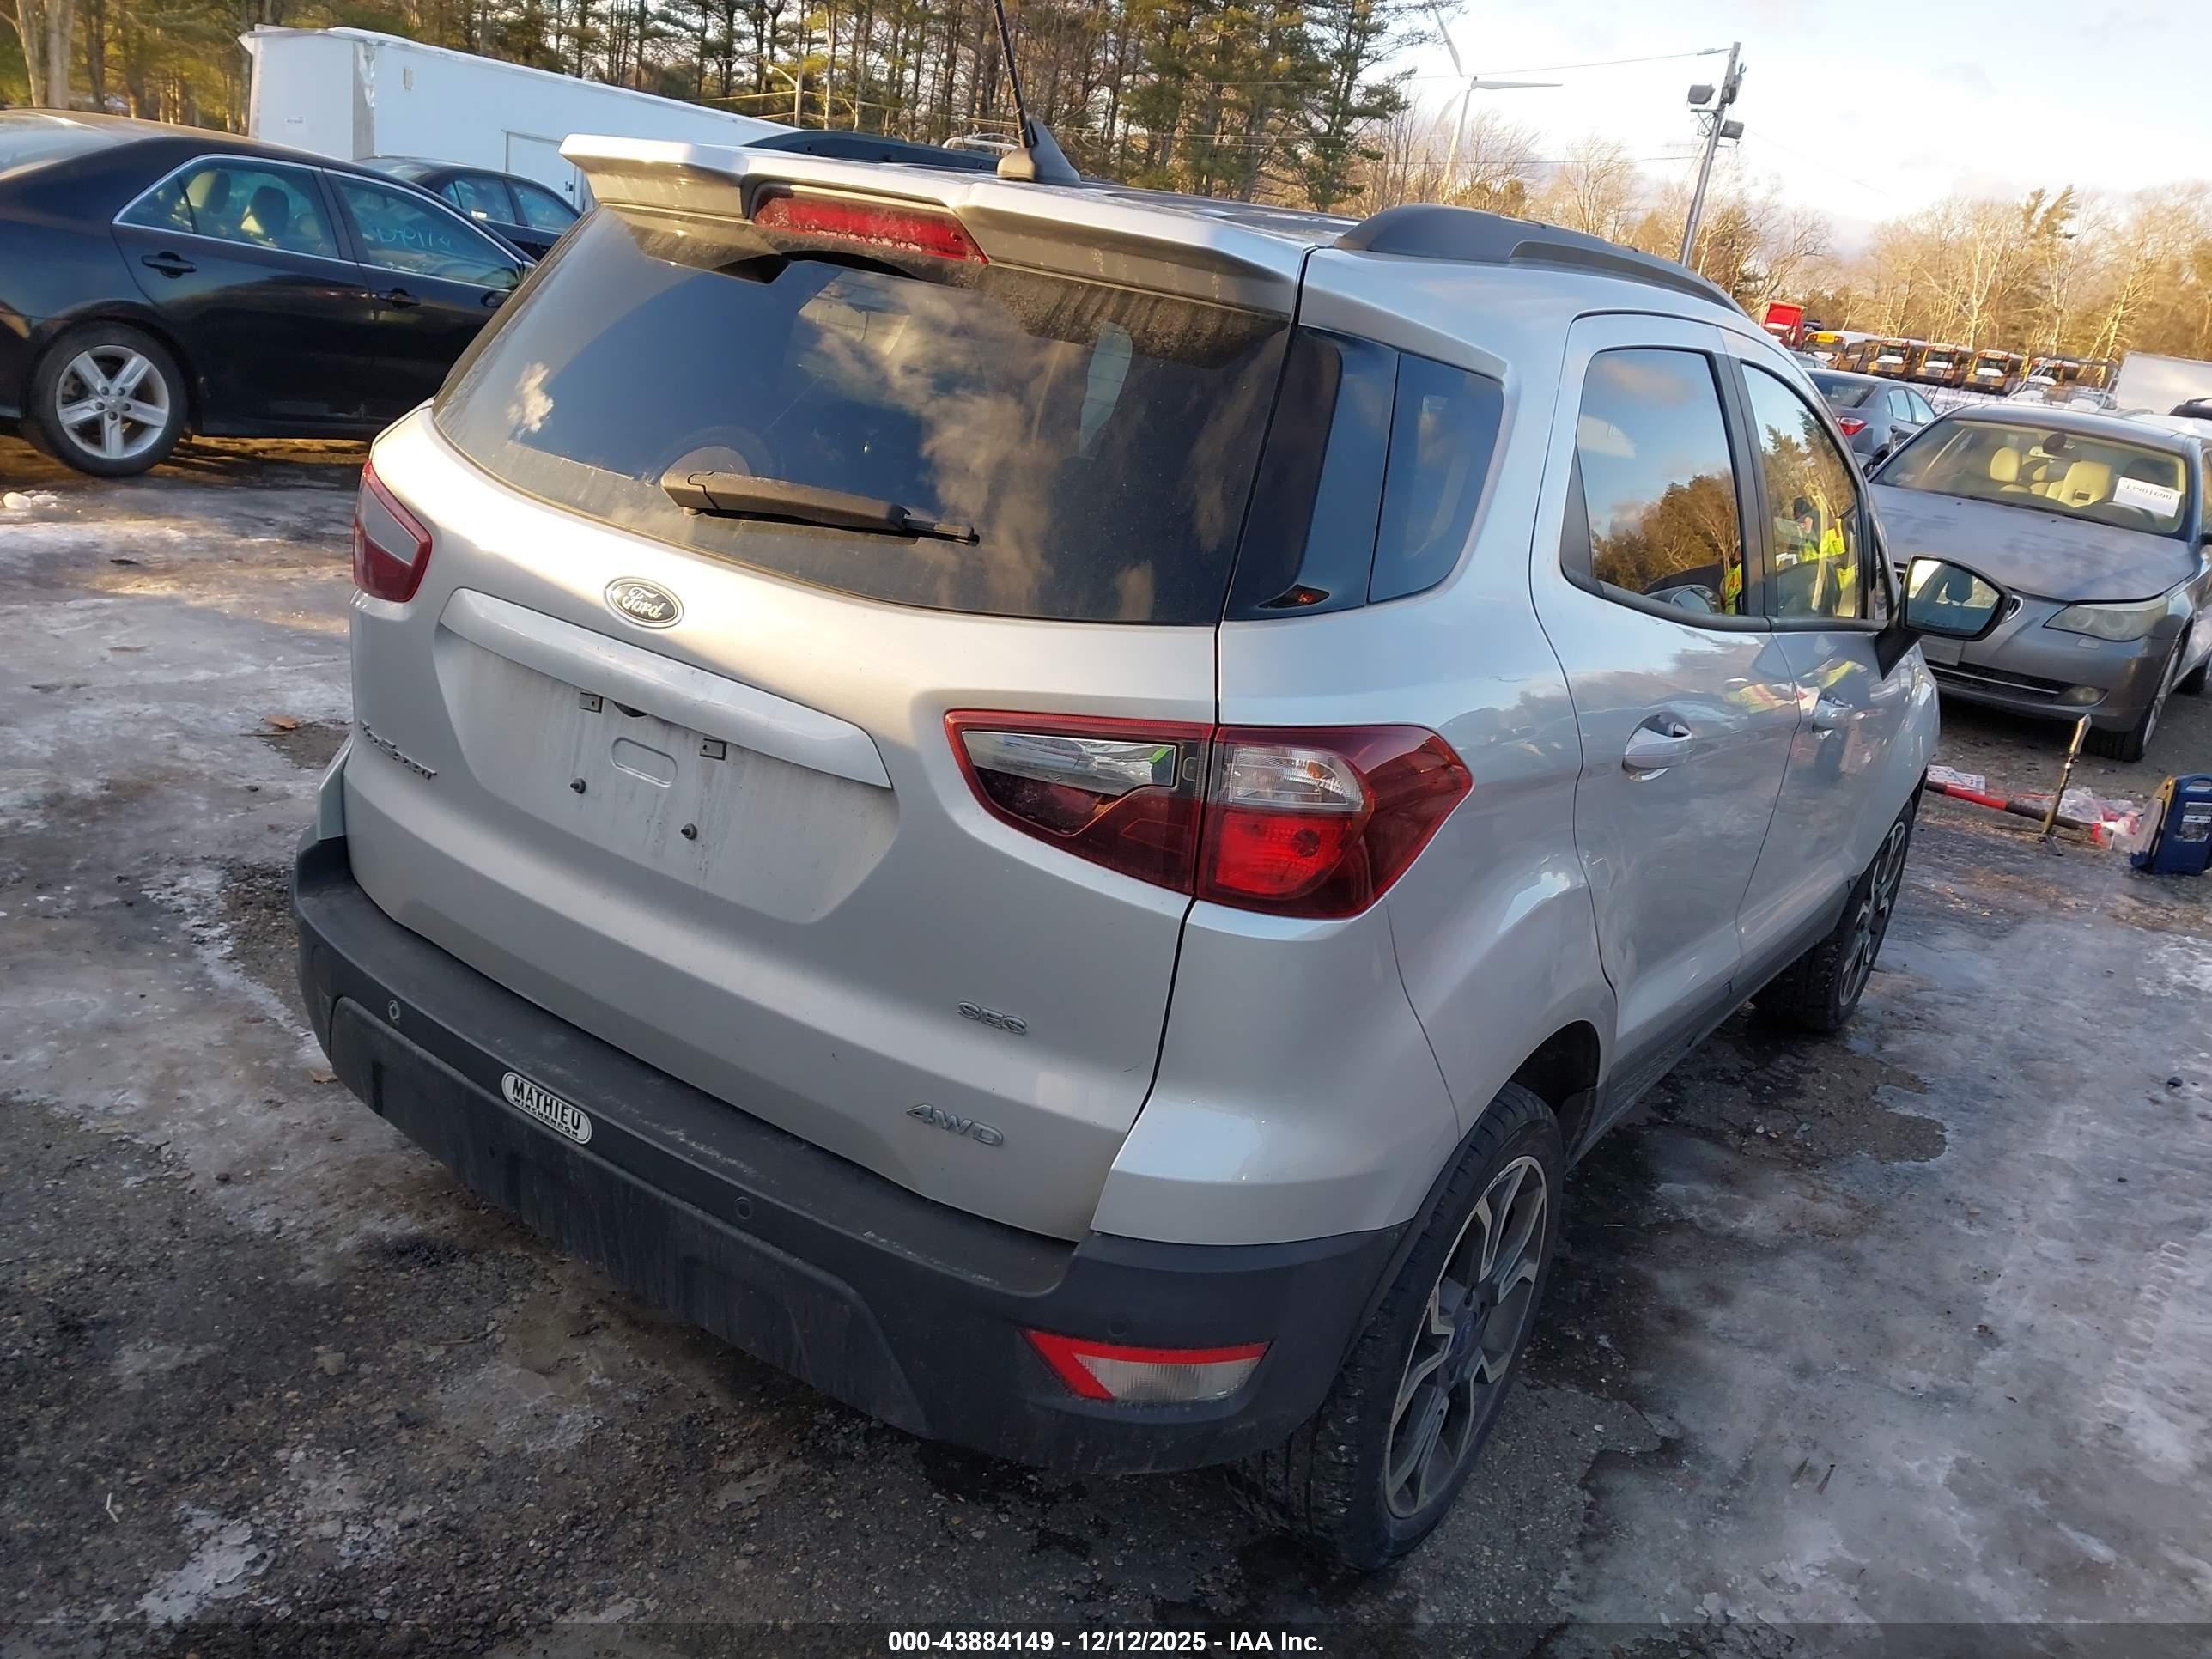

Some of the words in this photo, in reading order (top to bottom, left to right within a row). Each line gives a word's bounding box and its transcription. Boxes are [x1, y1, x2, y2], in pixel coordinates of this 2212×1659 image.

[621, 586, 666, 618] Ford
[957, 1000, 1028, 1036] SES
[513, 1078, 582, 1131] MATHIEU
[513, 1097, 579, 1138] WINCHENDON
[906, 1103, 1004, 1147] 4WD
